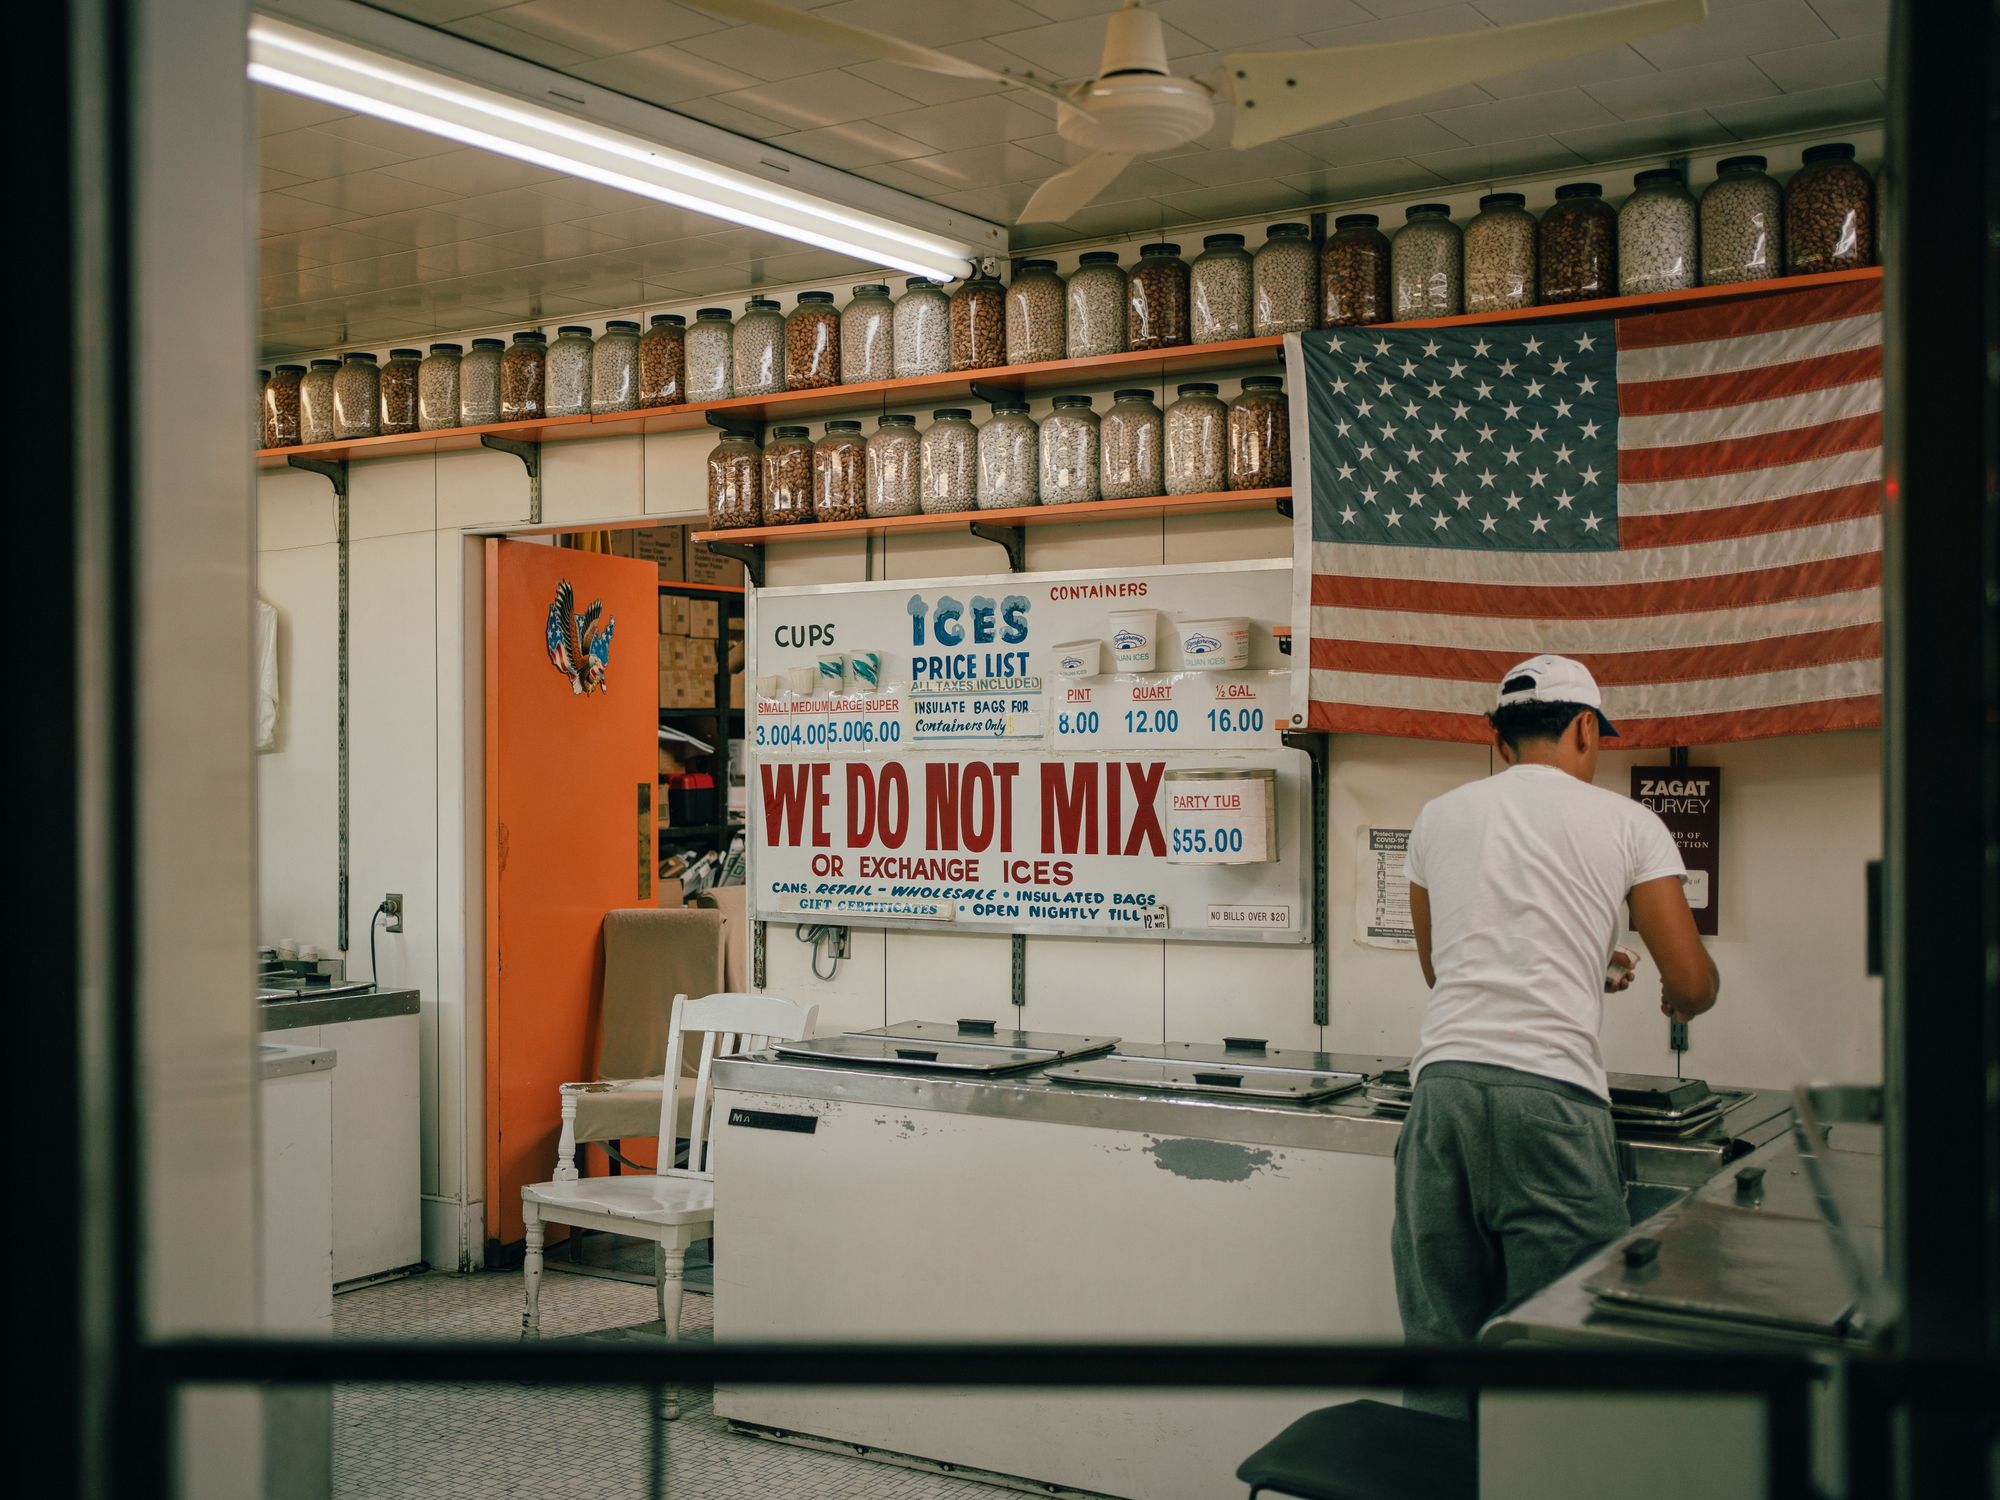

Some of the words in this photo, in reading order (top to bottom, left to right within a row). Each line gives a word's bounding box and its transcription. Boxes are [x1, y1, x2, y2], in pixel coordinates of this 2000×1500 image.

[1050, 582, 1148, 601] CONTAINERS
[907, 594, 1031, 646] ICES
[774, 623, 835, 648] CUPS
[912, 654, 976, 680] PRICE
[985, 651, 1030, 678] LIST
[911, 681, 932, 692] ALL
[936, 679, 973, 692] TAXES
[976, 677, 1040, 691] INCLUDED
[1132, 686, 1172, 699] QUART
[1228, 684, 1256, 698] GAL.
[1067, 688, 1092, 701] PINT
[758, 702, 789, 714] SMALL
[791, 700, 829, 713] MEDIUM
[829, 699, 863, 712] LARGE
[865, 699, 900, 711] SUPER
[914, 700, 965, 714] INSULATE
[973, 699, 1006, 714] BAGS
[1011, 700, 1029, 713] FOR
[915, 718, 982, 732] Containers
[985, 718, 1007, 737] Only
[1058, 711, 1099, 735] 8.00
[1124, 709, 1179, 733] 12.00
[1207, 708, 1264, 733] 16.00
[756, 725, 790, 746] 3.00
[791, 723, 827, 745] 4.00
[828, 721, 863, 743] 5.00
[863, 720, 900, 743] 6.00
[1640, 780, 1710, 796] ZAGAT
[760, 763, 831, 848] WE
[846, 761, 910, 850] DO
[925, 761, 1020, 853] NOT
[1040, 761, 1167, 857] MIX
[1173, 795, 1209, 808] PARTY
[1213, 795, 1241, 808] TUB
[1641, 798, 1711, 814] SURVEY
[1173, 827, 1243, 855] $55.00
[1687, 831, 1701, 839] OF
[811, 853, 844, 878] OR
[859, 855, 980, 882] EXCHANGE
[1003, 860, 1074, 886] ICES
[815, 883, 873, 896] RETAIL
[890, 885, 997, 901] WHOLESALE
[1016, 890, 1105, 905] INSULATED
[1112, 893, 1156, 906] BAGS
[799, 898, 833, 910] GIFT
[837, 899, 938, 915] CERTIFICATES
[972, 903, 1020, 918] OPEN
[1028, 905, 1101, 920] NIGHTLY
[1108, 907, 1141, 922] TILL
[1143, 914, 1153, 929] 12
[1211, 912, 1221, 921] NO
[1223, 912, 1246, 921] BILLS
[1248, 911, 1269, 921] OVER
[1270, 911, 1286, 922] $20
